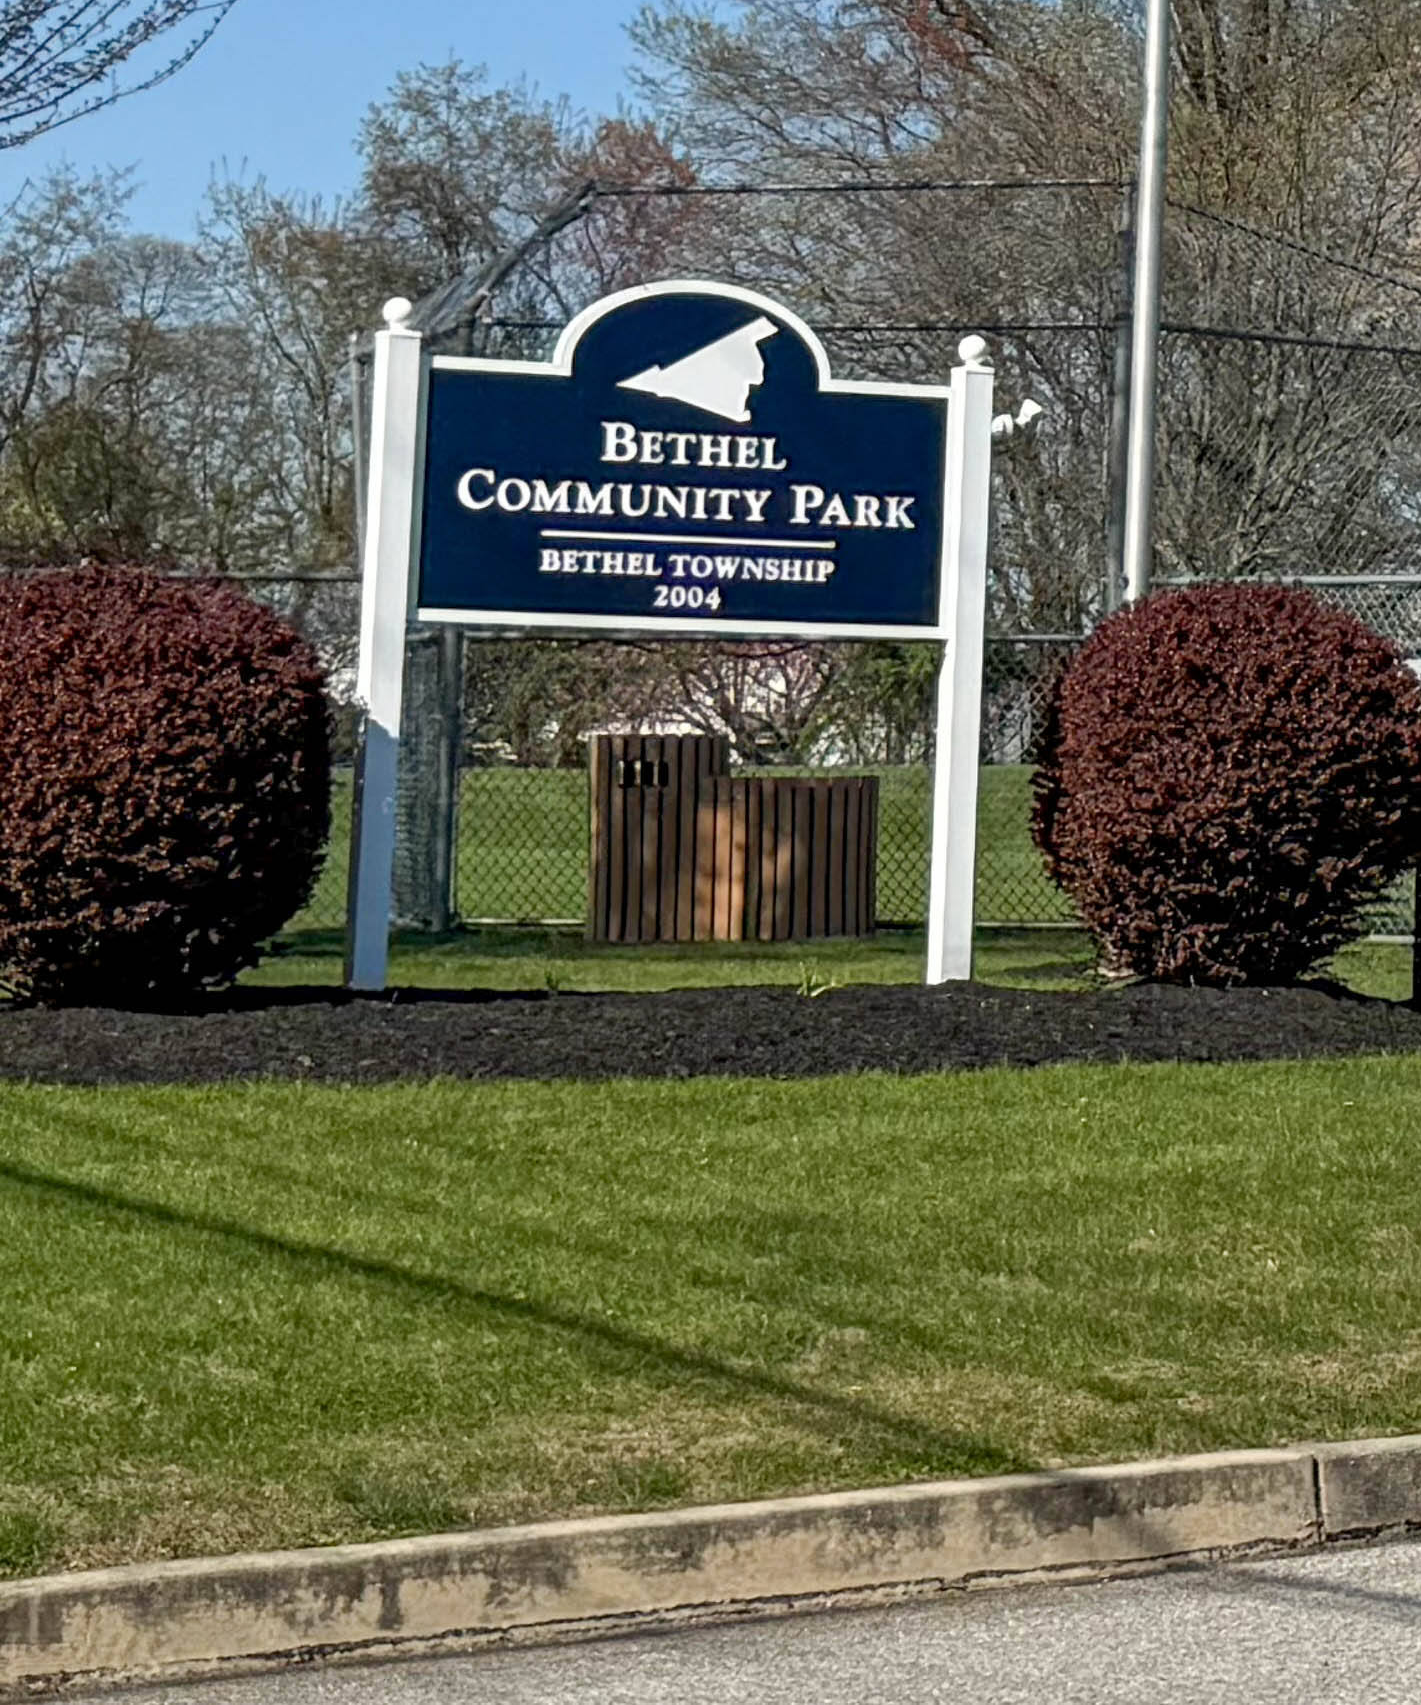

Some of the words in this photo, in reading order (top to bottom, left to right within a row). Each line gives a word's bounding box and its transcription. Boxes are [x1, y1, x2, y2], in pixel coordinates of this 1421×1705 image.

[538, 548, 664, 577] BETHEL
[668, 553, 837, 583] TOWNSHIP
[651, 584, 722, 611] 2004
